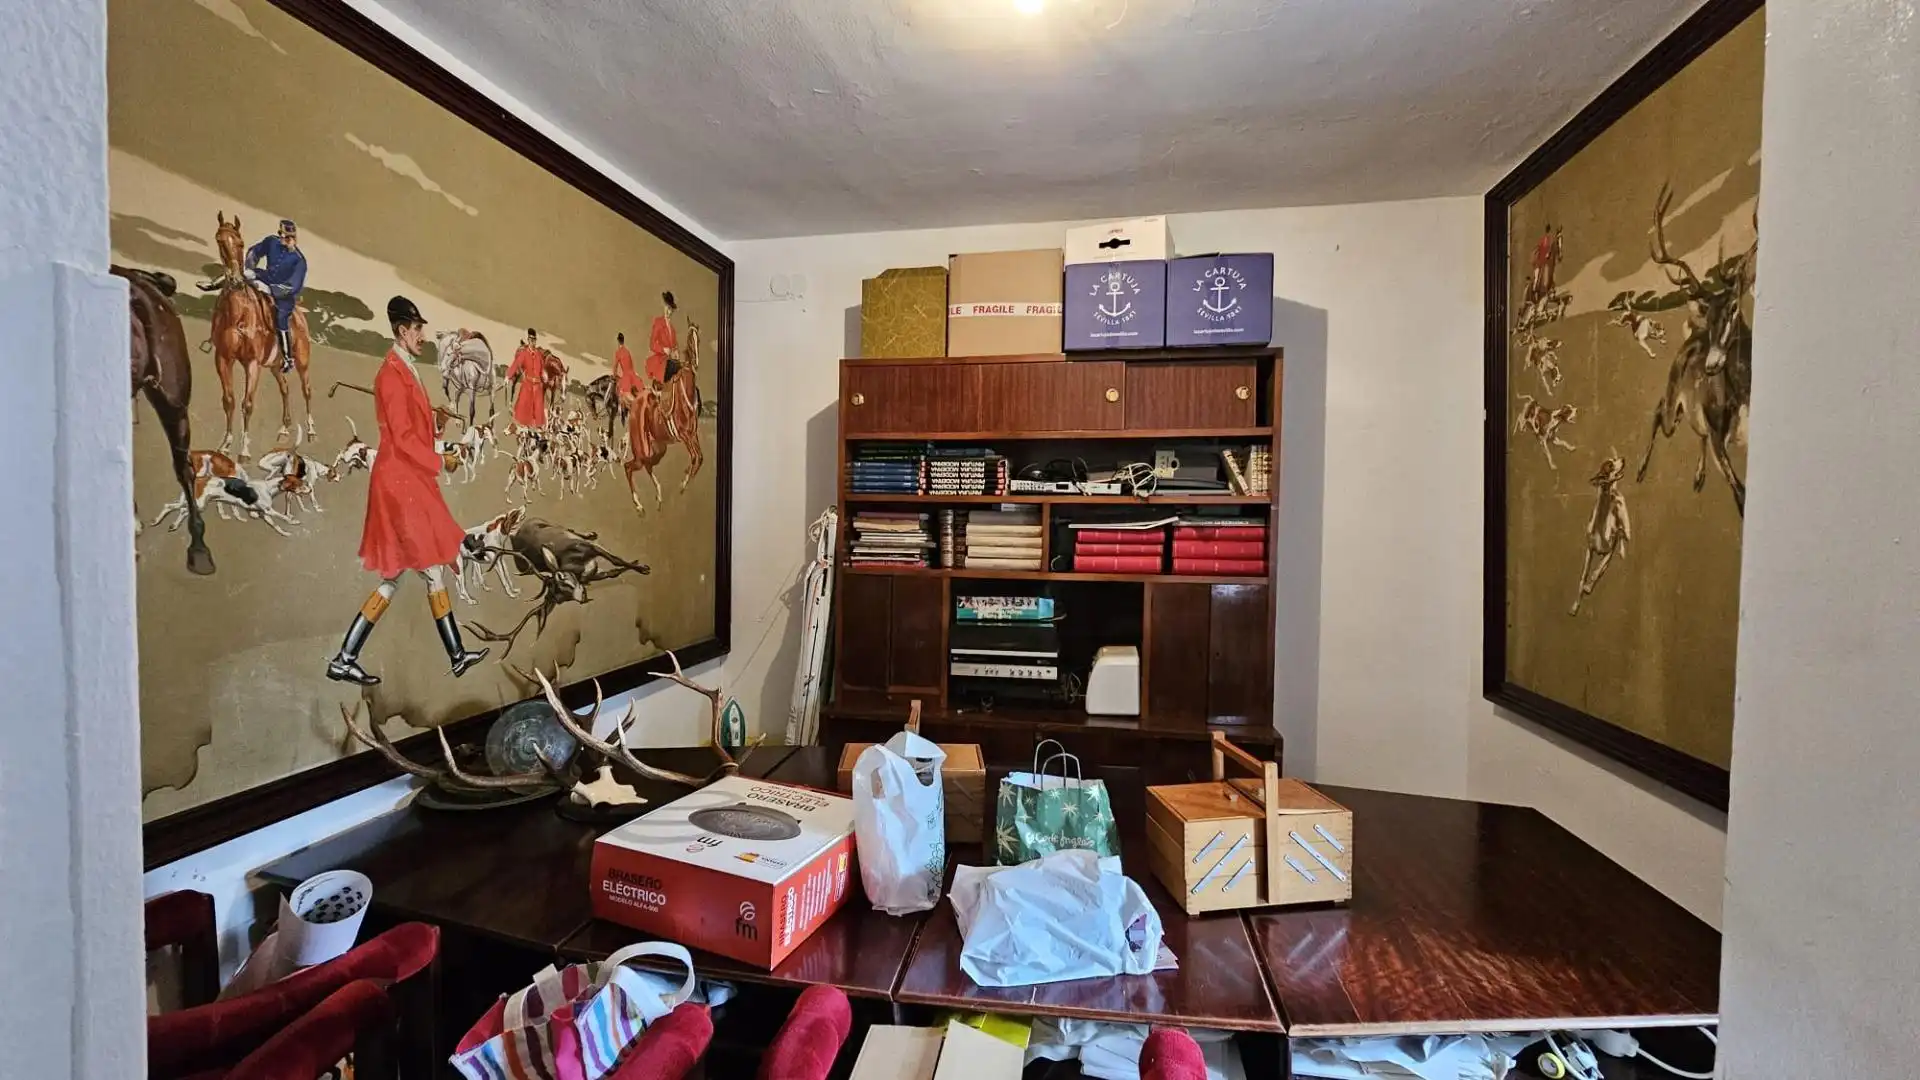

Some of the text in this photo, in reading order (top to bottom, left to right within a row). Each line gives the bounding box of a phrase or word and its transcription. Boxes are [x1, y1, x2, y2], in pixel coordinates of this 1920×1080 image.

[1089, 272, 1141, 296] LA CARTUJA
[1192, 267, 1247, 292] LA CARTUJA
[973, 305, 1015, 314] FRAGILE
[1093, 311, 1120, 325] SEVILLA
[1197, 307, 1225, 322] SEVILLA
[747, 792, 816, 812] BRASERO
[608, 867, 663, 890] BRASERO
[602, 880, 666, 906] ELÉCTRICO
[736, 917, 758, 941] fm
